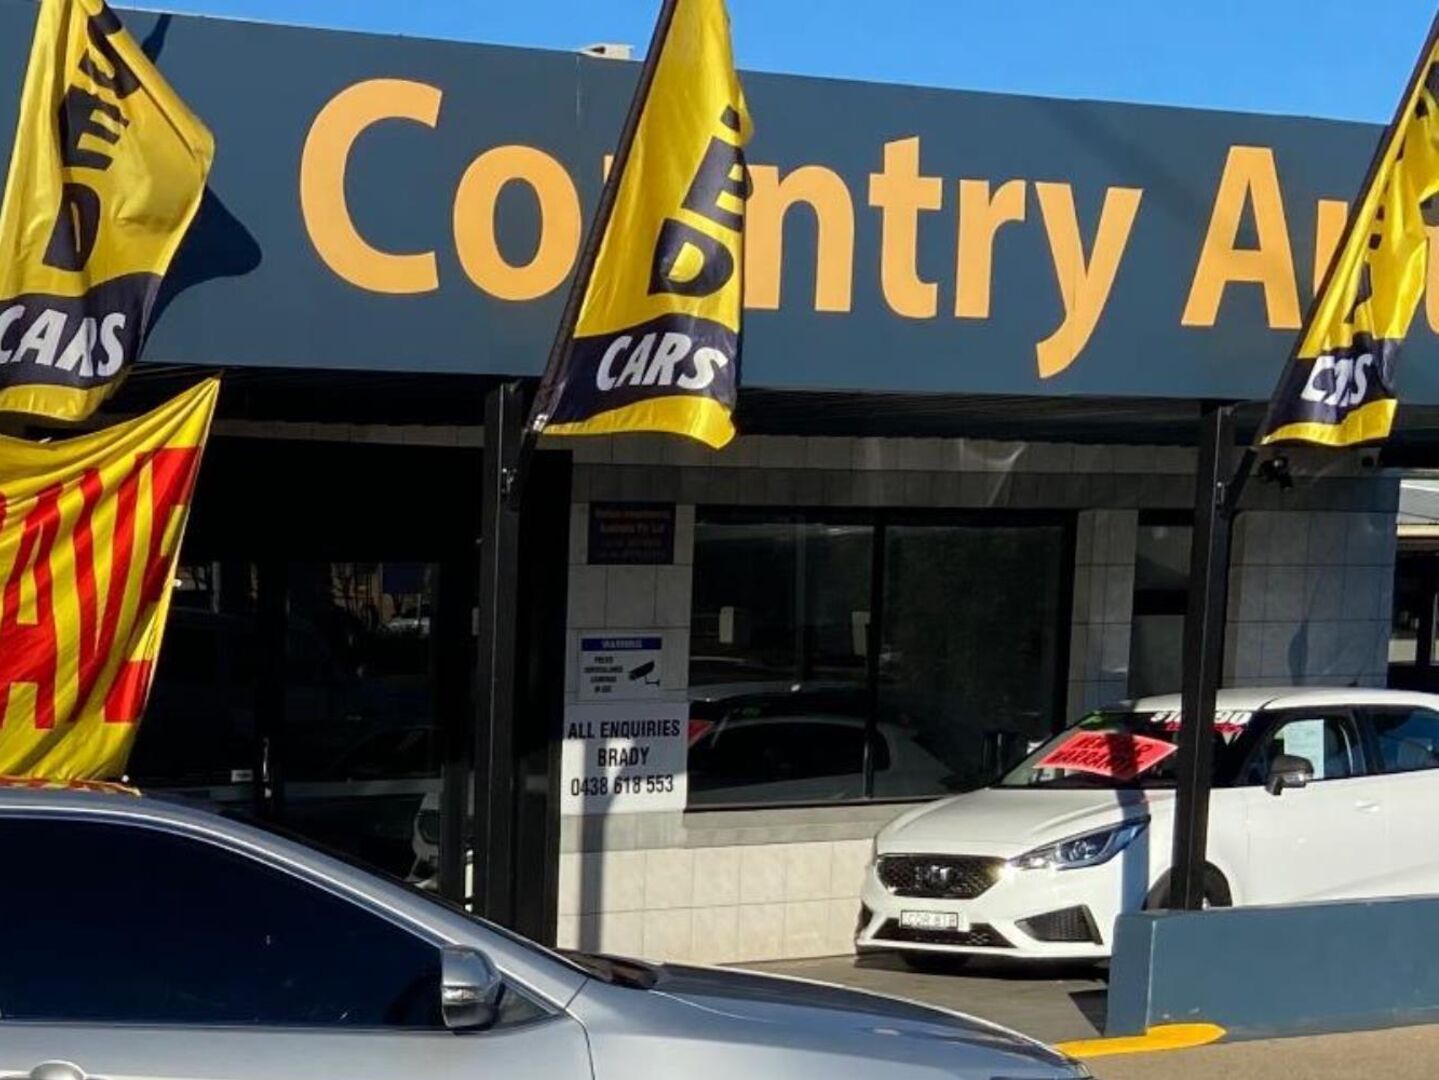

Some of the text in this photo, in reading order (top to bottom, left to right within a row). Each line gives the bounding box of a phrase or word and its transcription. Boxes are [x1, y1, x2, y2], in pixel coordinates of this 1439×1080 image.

[299, 77, 1144, 380] Contry
[595, 332, 728, 392] CARS
[567, 719, 681, 740] ALL ENQUIRIES
[597, 746, 650, 768] BRADY
[570, 774, 674, 797] 0438 618 553
